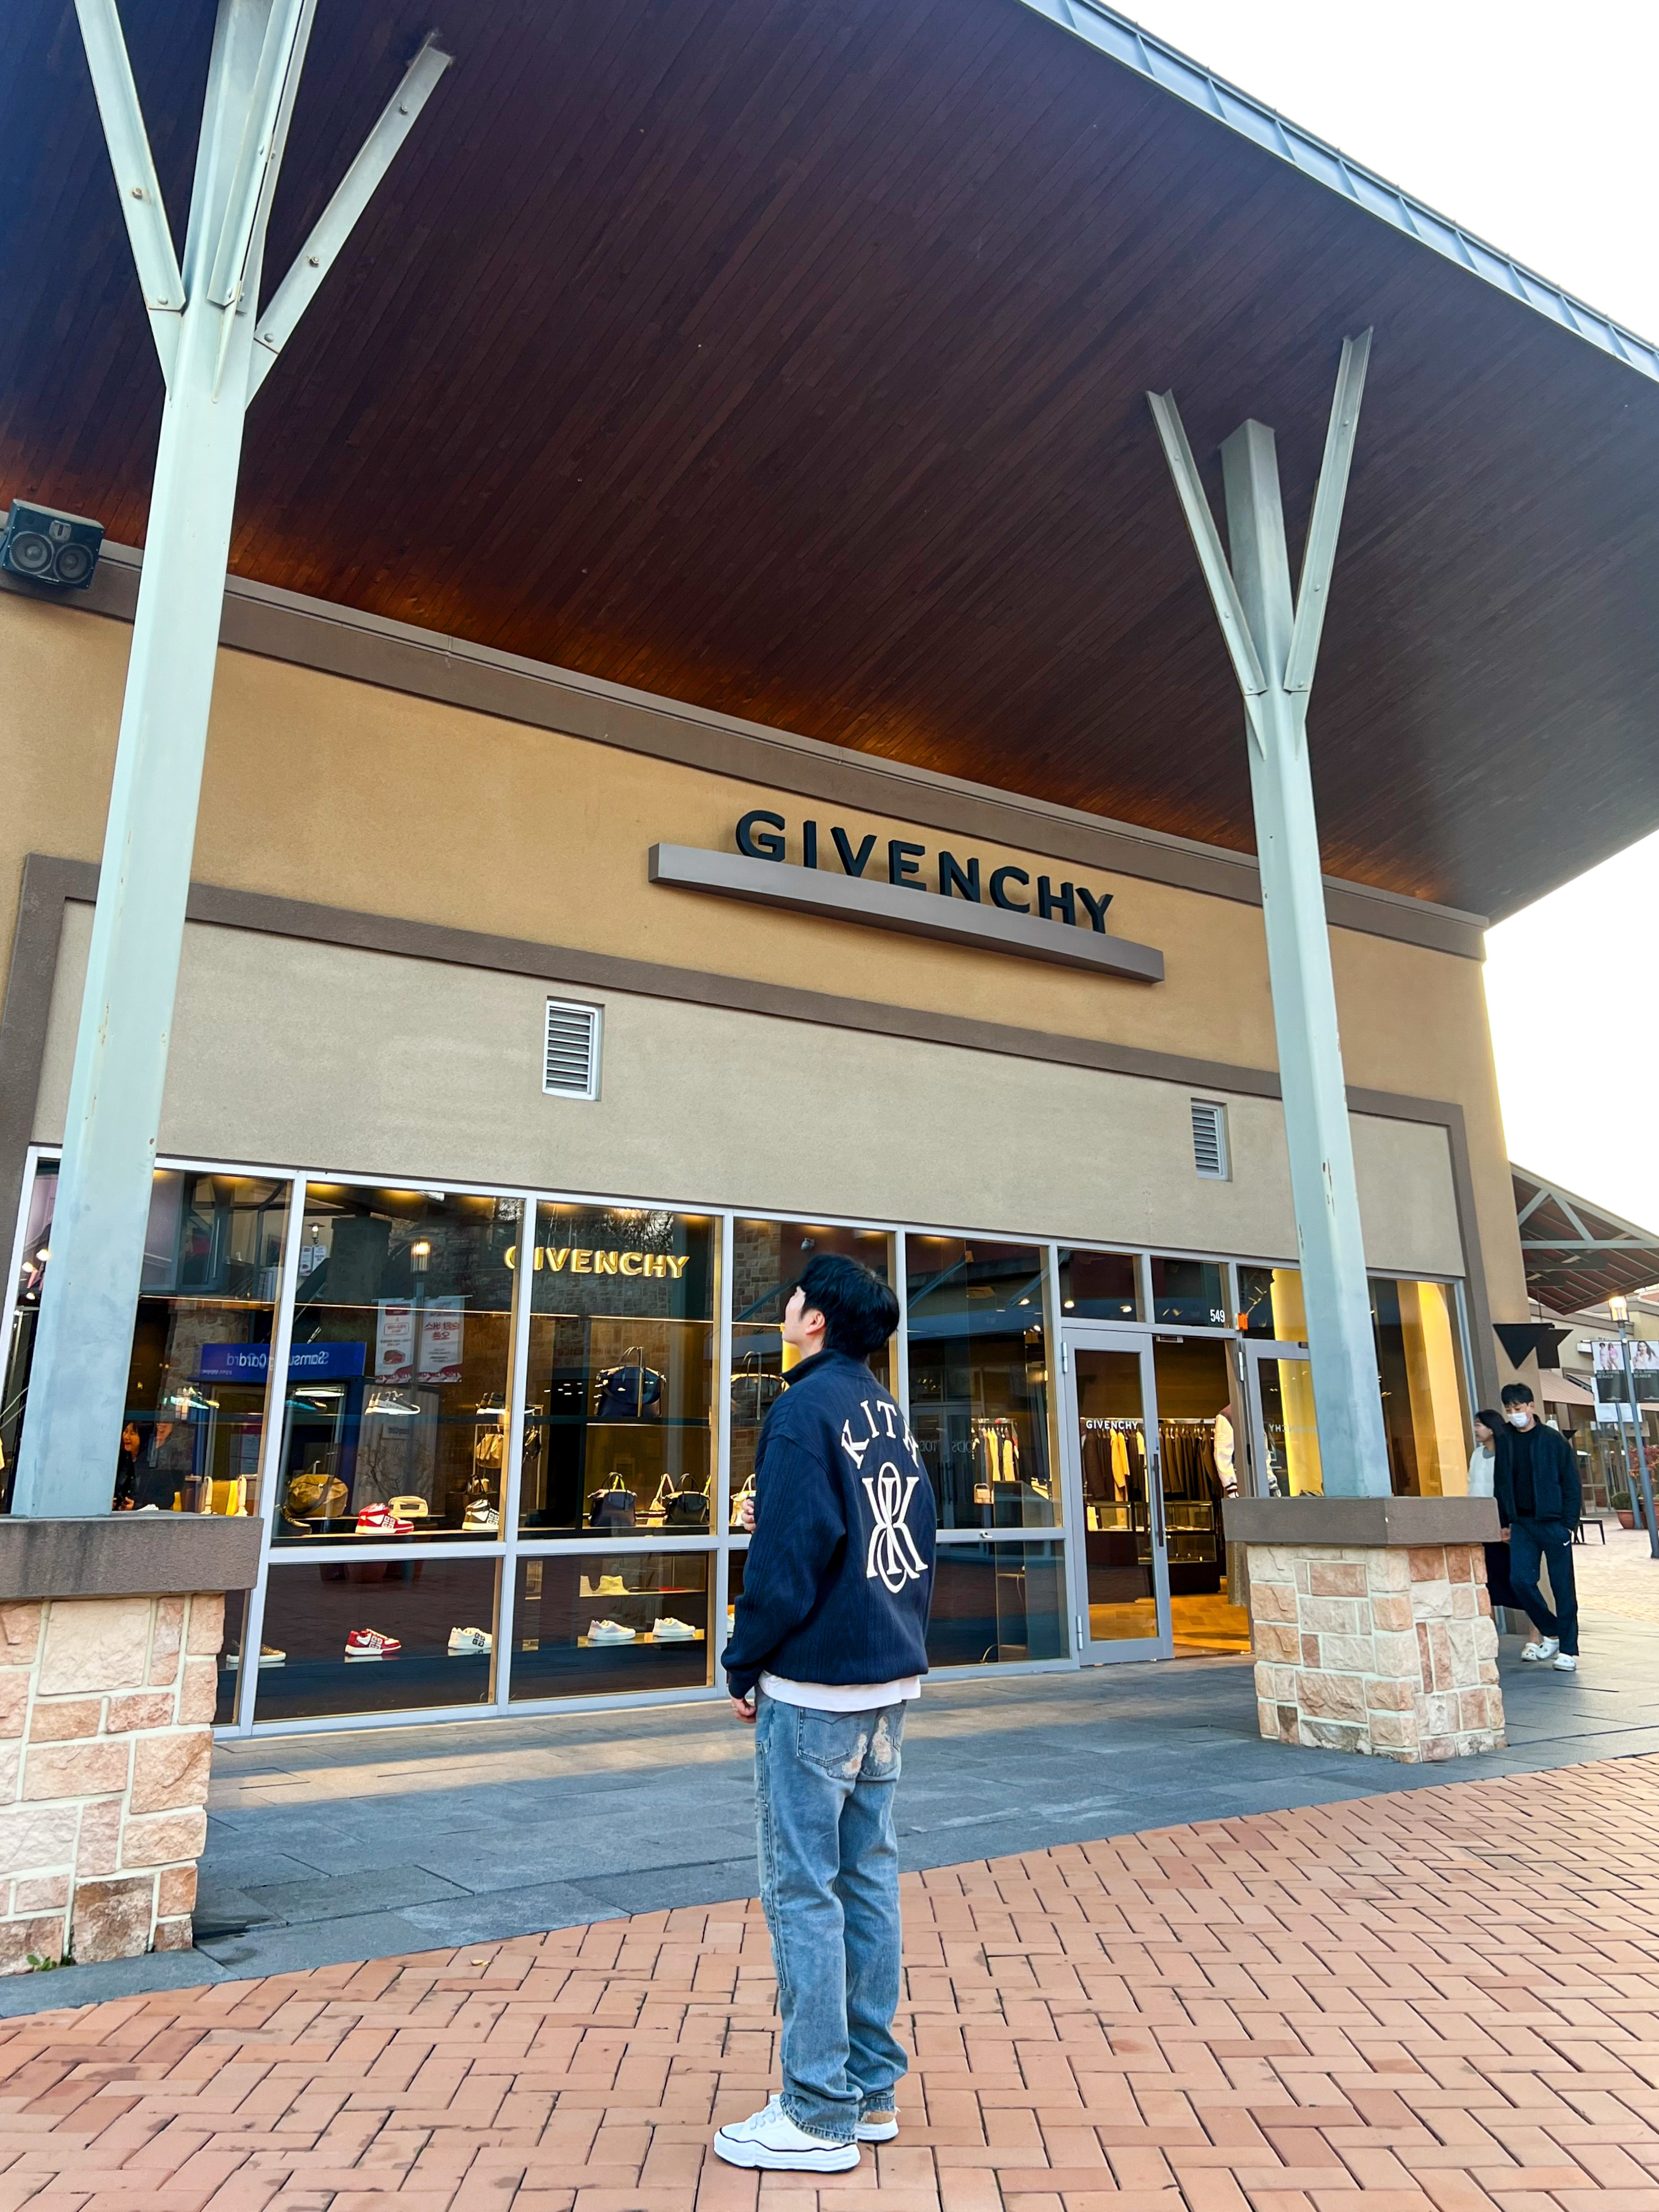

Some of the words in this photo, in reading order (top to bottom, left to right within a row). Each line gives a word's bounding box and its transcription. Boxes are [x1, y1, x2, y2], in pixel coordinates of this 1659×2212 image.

[735, 811, 1114, 934] GIVENCHY
[1210, 1309, 1225, 1323] 549
[1086, 1420, 1138, 1430] GIVENCHY
